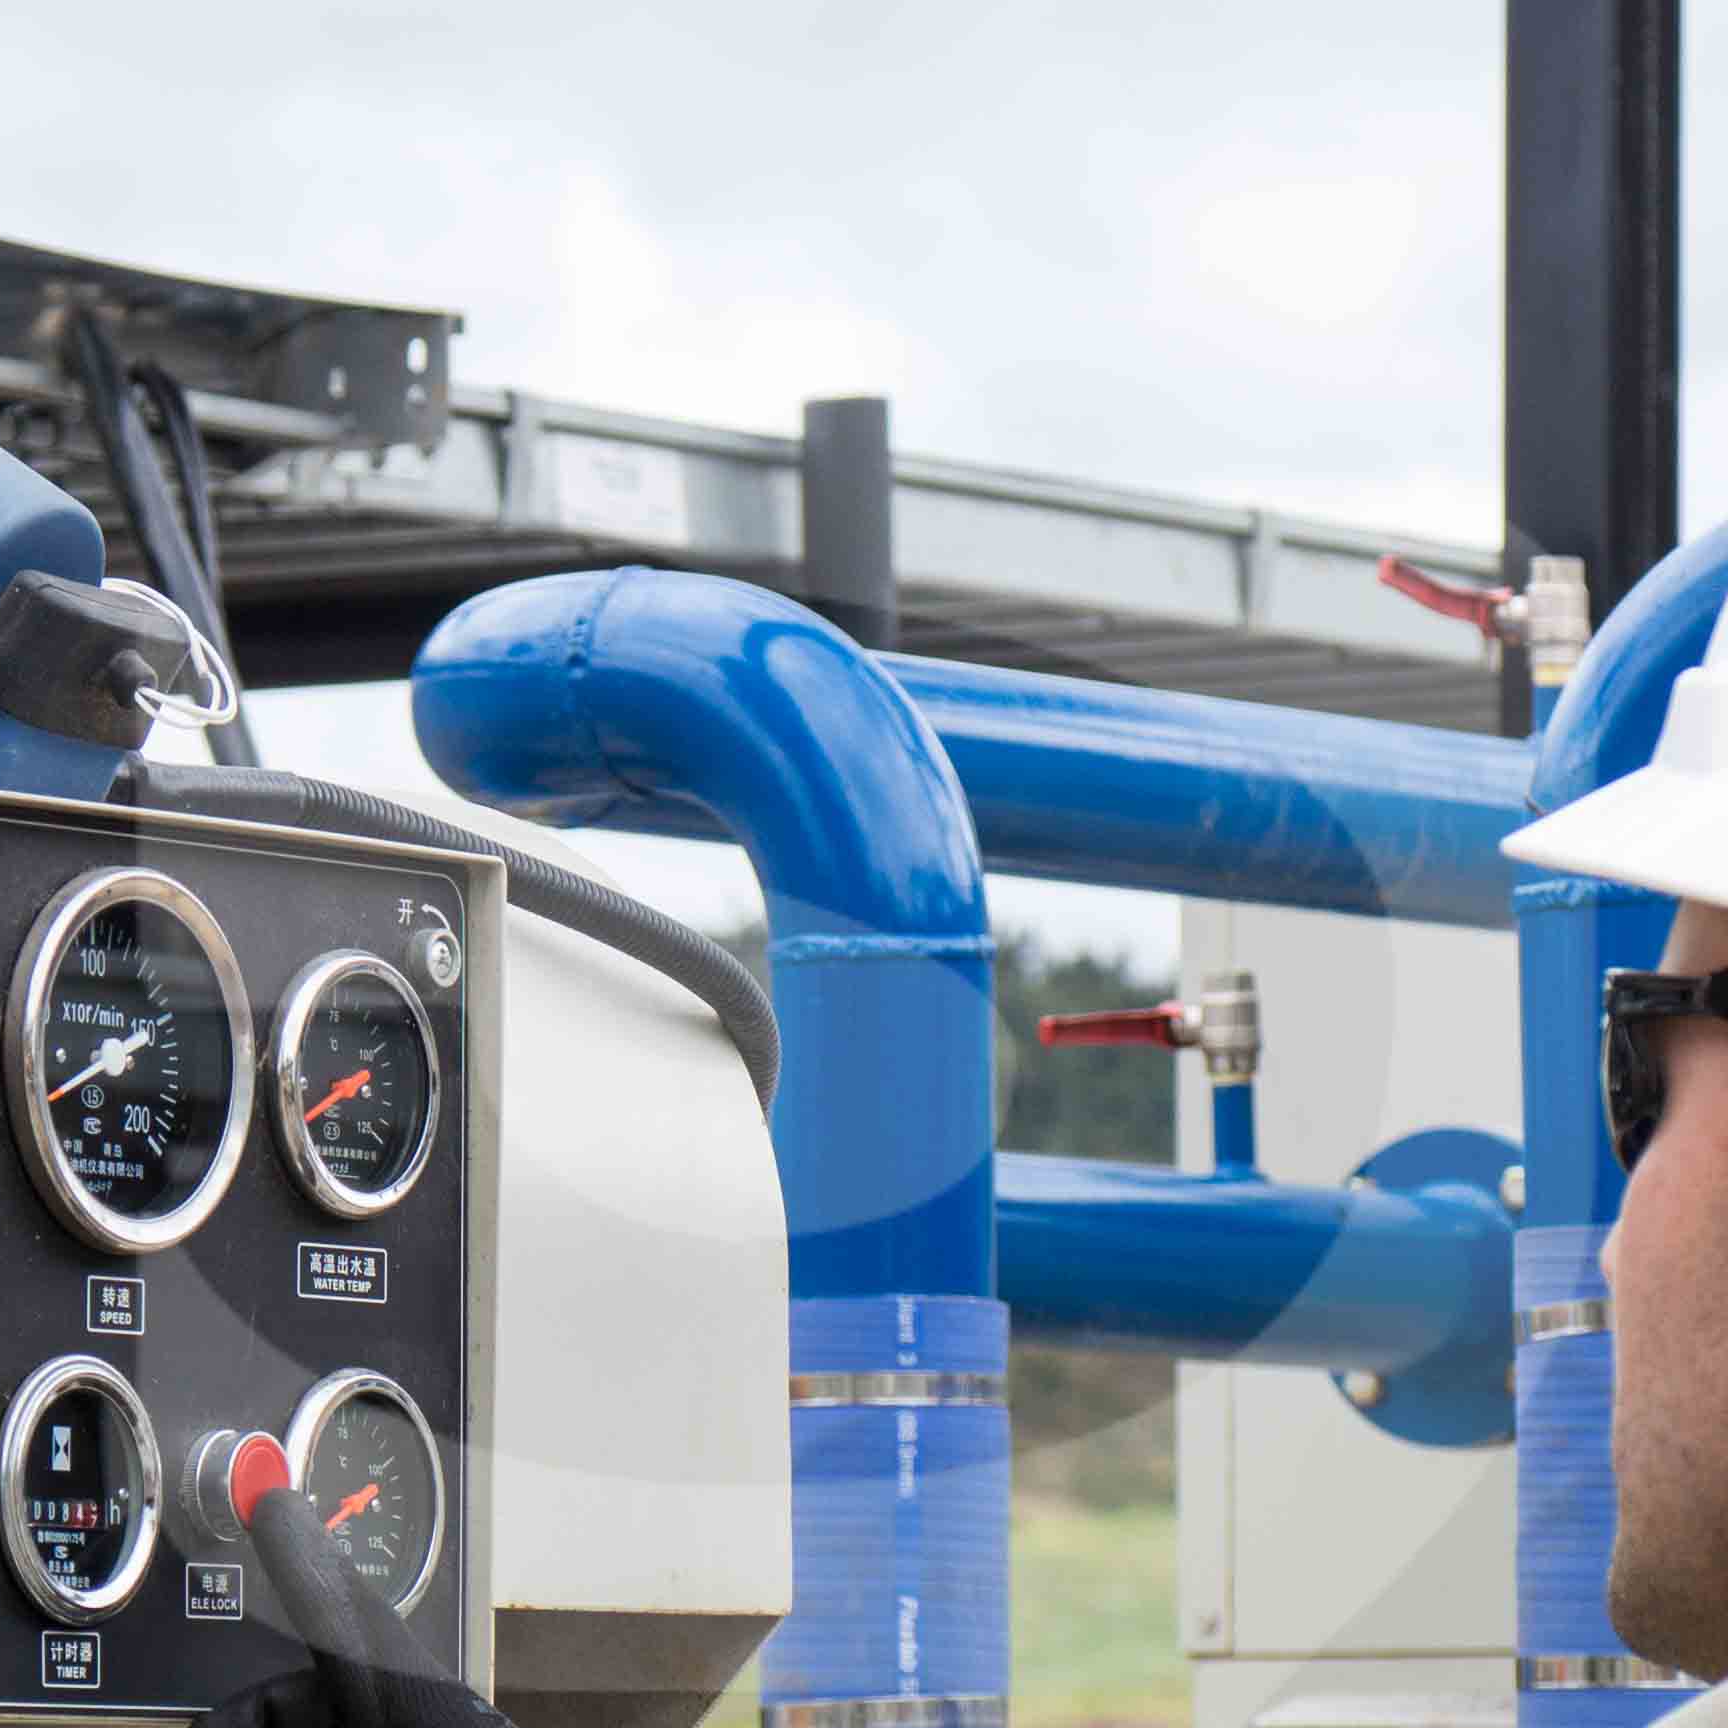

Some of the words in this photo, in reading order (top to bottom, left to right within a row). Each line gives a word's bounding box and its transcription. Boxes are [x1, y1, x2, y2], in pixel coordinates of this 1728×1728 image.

[397, 897, 415, 926] 开
[80, 948, 106, 977] 100
[124, 1103, 150, 1132] 200
[313, 1276, 345, 1292] WATER
[346, 1279, 372, 1294] TEMP
[99, 1310, 133, 1326] SPEED
[191, 1597, 209, 1610] ELE
[211, 1598, 238, 1611] LOCK
[50, 1640, 93, 1663] 计时器
[55, 1665, 88, 1680] TIMER
